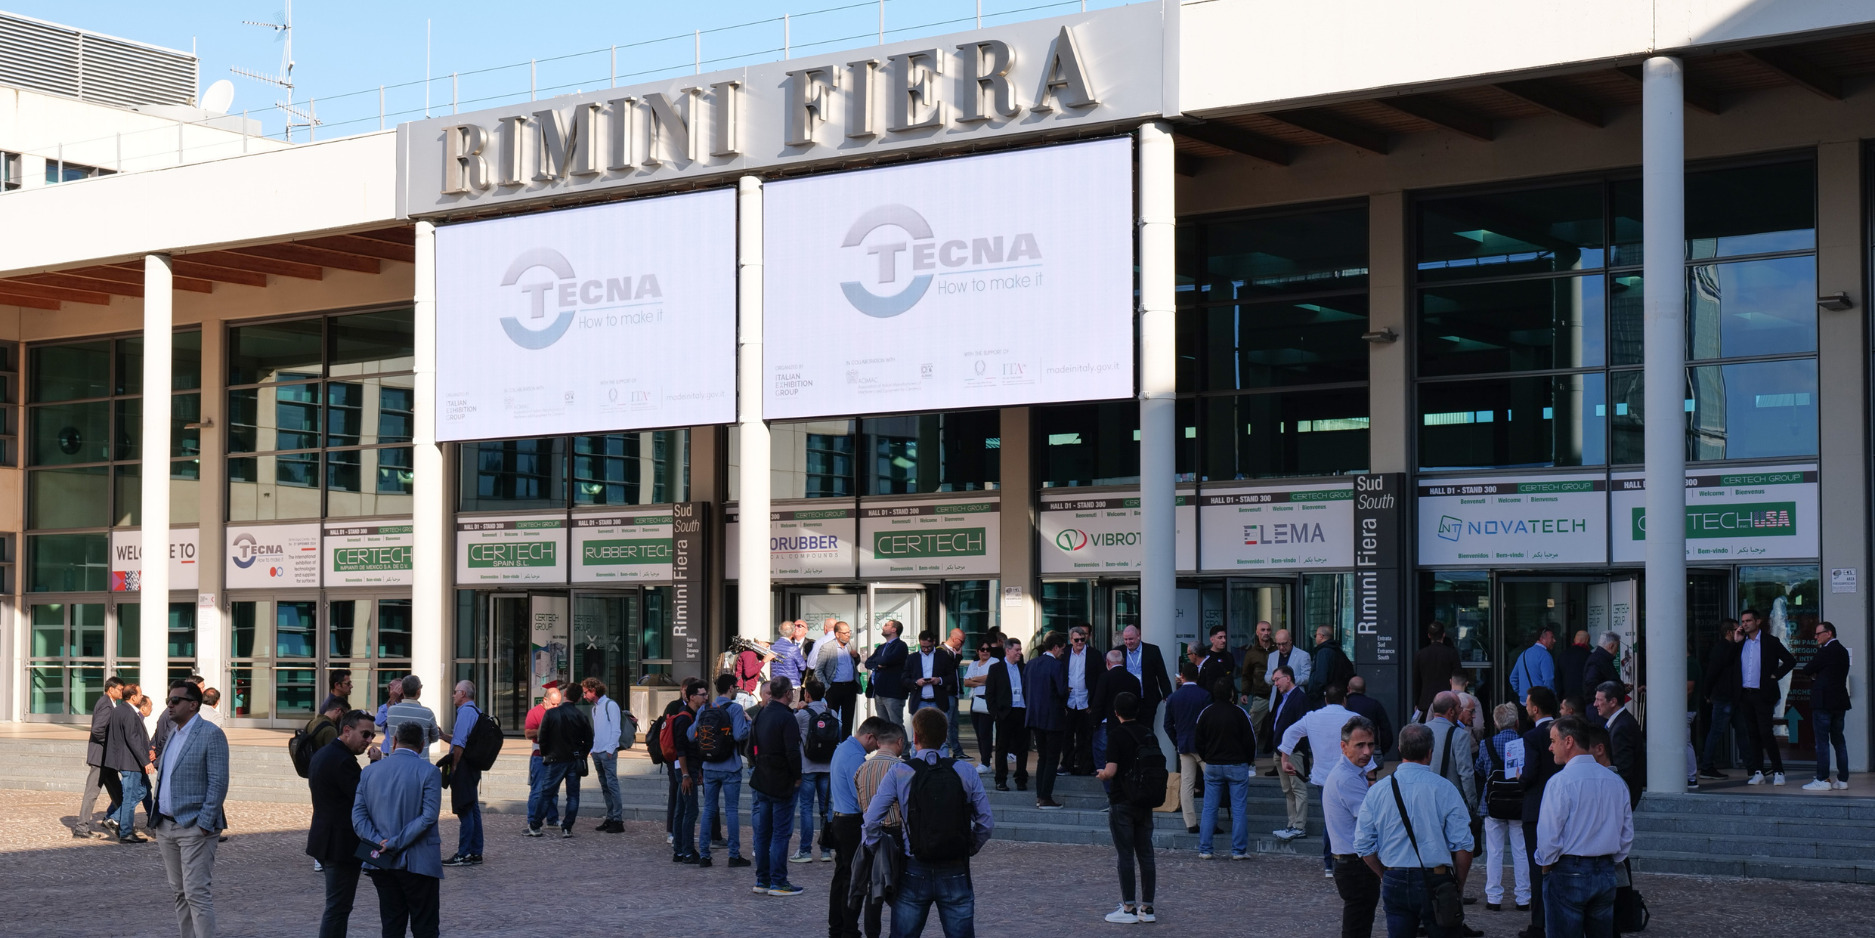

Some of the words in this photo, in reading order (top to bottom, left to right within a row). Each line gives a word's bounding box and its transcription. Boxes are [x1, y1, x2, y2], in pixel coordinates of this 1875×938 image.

[441, 80, 741, 194] RIMINI
[785, 25, 1100, 146] FIERA
[867, 233, 1042, 284] TECNA
[938, 281, 967, 295] How
[972, 278, 985, 292] to
[990, 275, 1030, 290] make
[1035, 272, 1043, 286] it
[521, 273, 663, 319] TECNA
[579, 316, 603, 329] How
[606, 315, 617, 327] to
[621, 311, 654, 325] make
[656, 309, 663, 321] it
[1046, 361, 1120, 374] madeinitaly.gov.it
[775, 373, 801, 381] ITALIAN
[775, 380, 813, 389] EXHIBITION
[1357, 475, 1383, 491] Sud
[1623, 481, 1641, 489] HALL
[1723, 475, 1766, 484] CERTECH
[1768, 474, 1800, 482] GROUP
[1429, 487, 1445, 495] HALL
[1462, 486, 1482, 494] STAND
[1357, 493, 1395, 510] South
[674, 504, 692, 517] Sud
[674, 519, 700, 532] South
[1468, 519, 1586, 535] NOVATECH
[1638, 511, 1753, 532] CTECH
[1754, 510, 1790, 528] USA
[770, 535, 838, 550] ORUBBER
[1090, 532, 1141, 547] VIBROT
[1243, 523, 1326, 545] ELEMA
[1357, 518, 1377, 566] Fiera
[116, 544, 175, 560] WELE
[179, 543, 195, 558] TO
[239, 544, 284, 558] TECNA
[585, 545, 637, 558] RUBBER
[639, 545, 673, 557] TECH
[878, 532, 982, 554] CERTECH
[336, 547, 413, 564] CERTECH
[470, 543, 553, 561] CERTECH
[674, 539, 688, 580] Fiera
[673, 584, 687, 637] Rimini
[1358, 572, 1377, 634] Rimini
